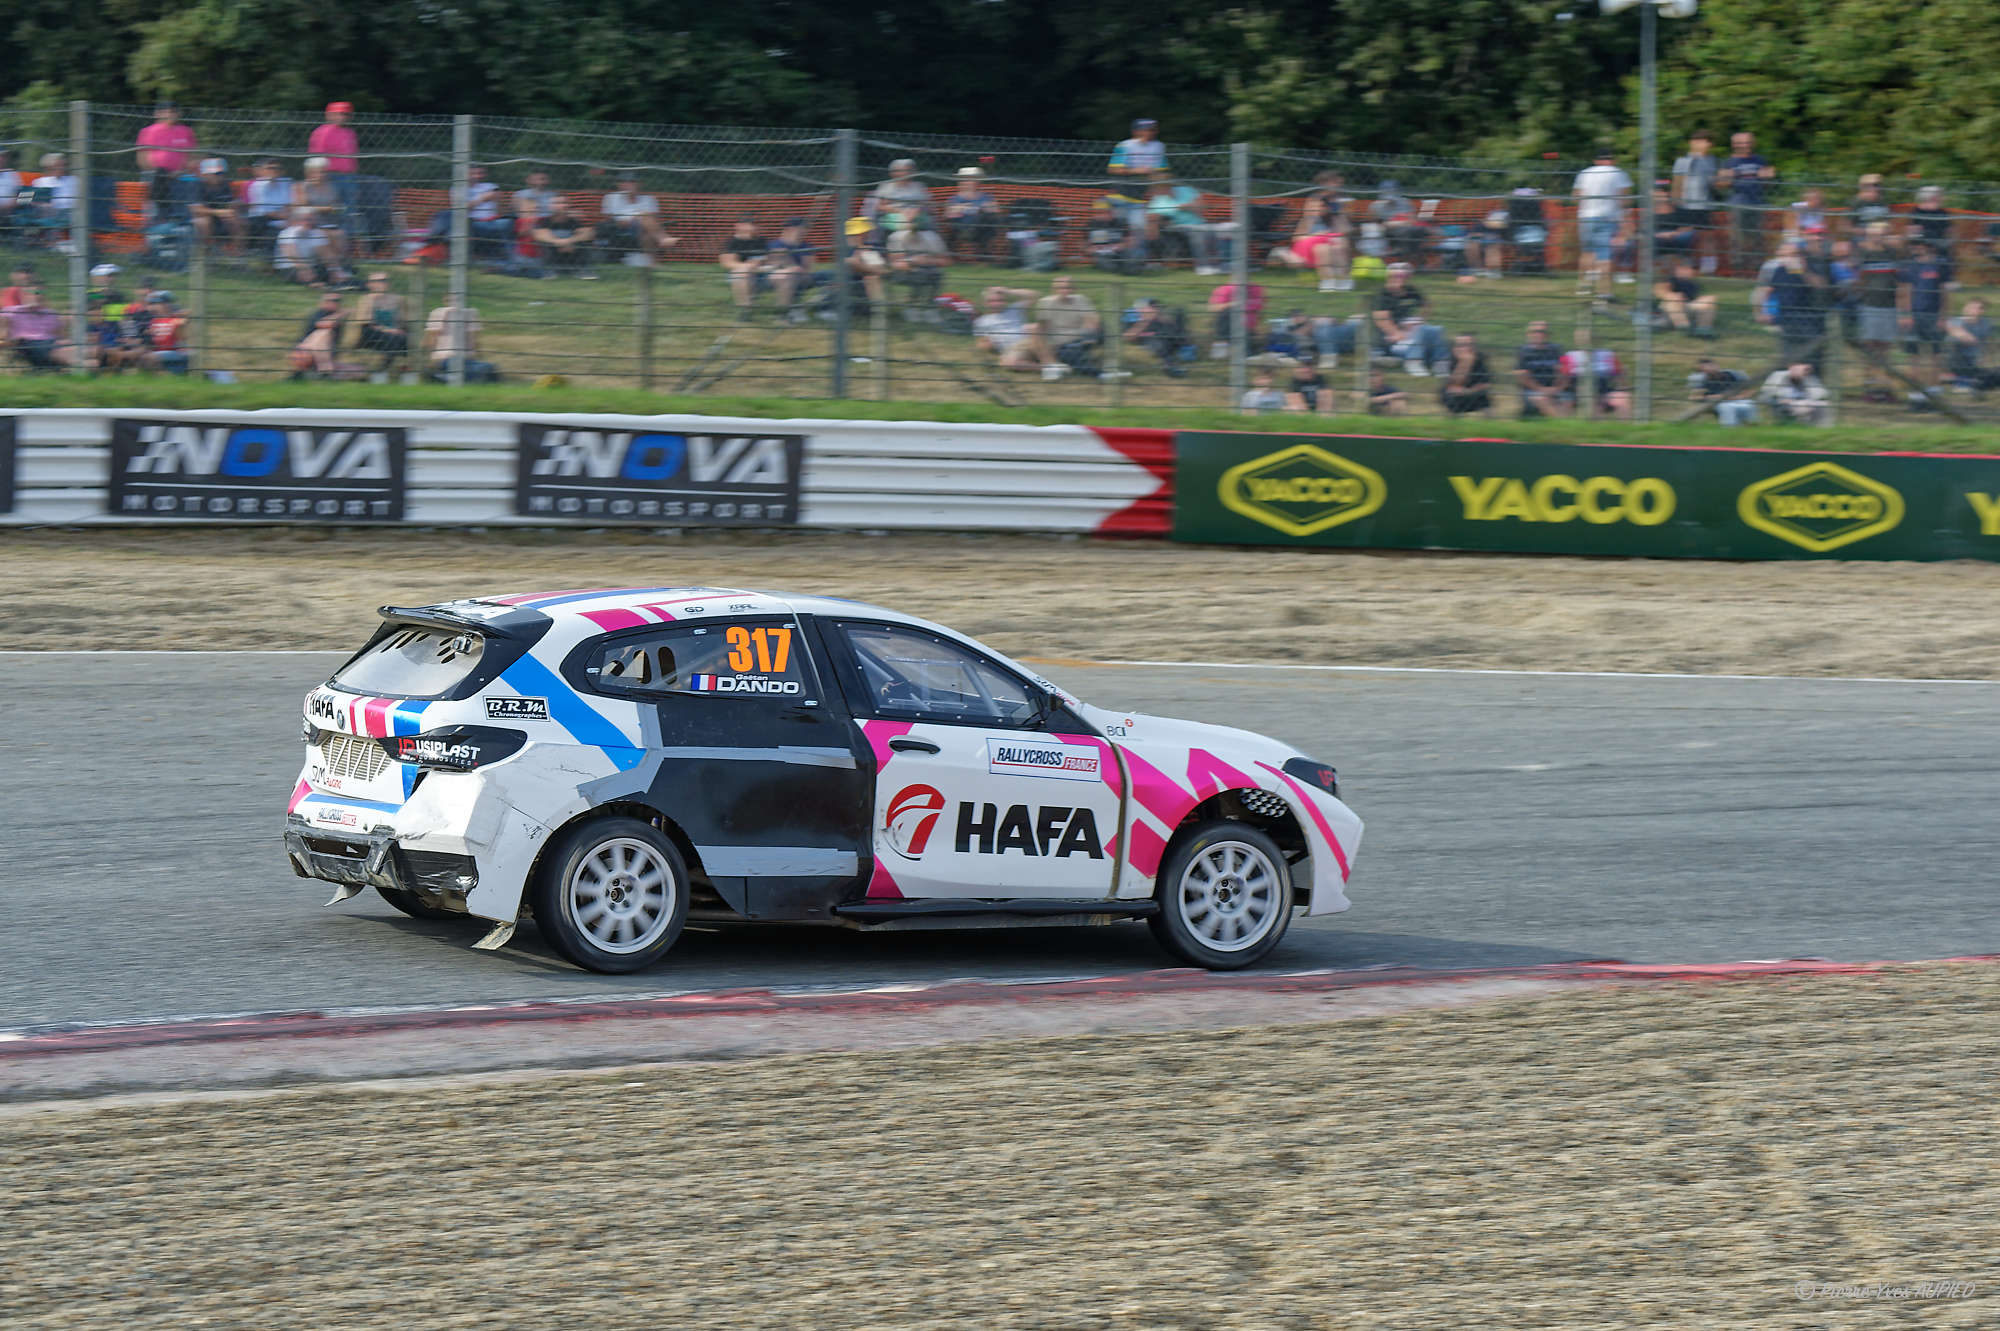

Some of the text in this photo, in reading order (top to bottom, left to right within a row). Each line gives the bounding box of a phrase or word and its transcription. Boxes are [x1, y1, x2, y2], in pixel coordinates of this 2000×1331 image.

[126, 425, 392, 479] NOVA
[531, 430, 789, 484] NOVA
[1243, 477, 1366, 503] YACCO
[1448, 474, 1677, 526] YACCO
[122, 494, 392, 517] MOTORSPORT
[528, 496, 788, 520] MOTORSPORT
[1763, 494, 1884, 520] YACCO
[725, 626, 792, 673] 317
[716, 677, 800, 694] DANDO
[415, 739, 481, 760] USIPLAST
[997, 747, 1097, 771] RALLYCROSS FRANCE
[955, 801, 1104, 860] HAFA
